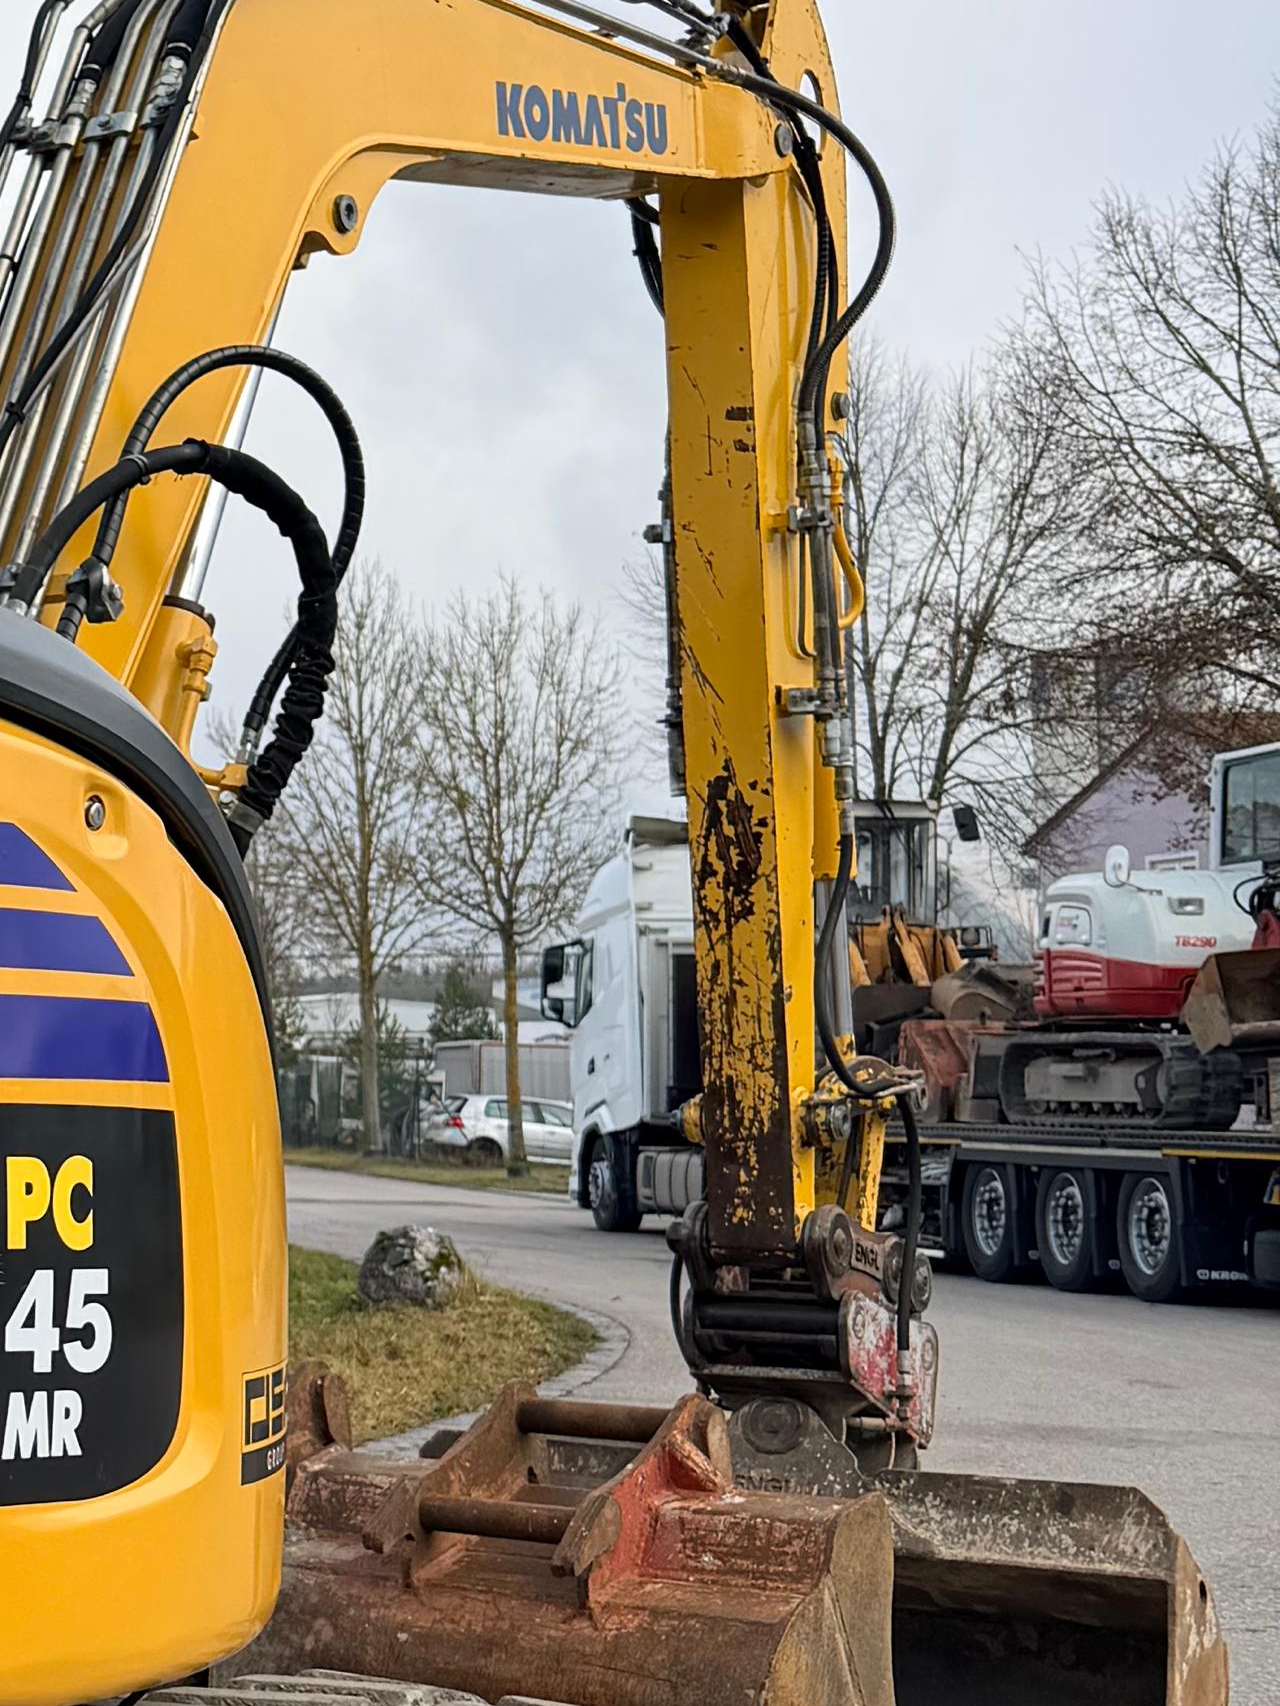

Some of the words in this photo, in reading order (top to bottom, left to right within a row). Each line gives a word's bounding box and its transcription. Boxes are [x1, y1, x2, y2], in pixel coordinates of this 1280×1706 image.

[495, 80, 668, 155] KOMATSU
[1175, 936, 1217, 948] TB290
[6, 1155, 93, 1251] PC
[4, 1268, 113, 1373] 45
[1, 1390, 83, 1460] MR
